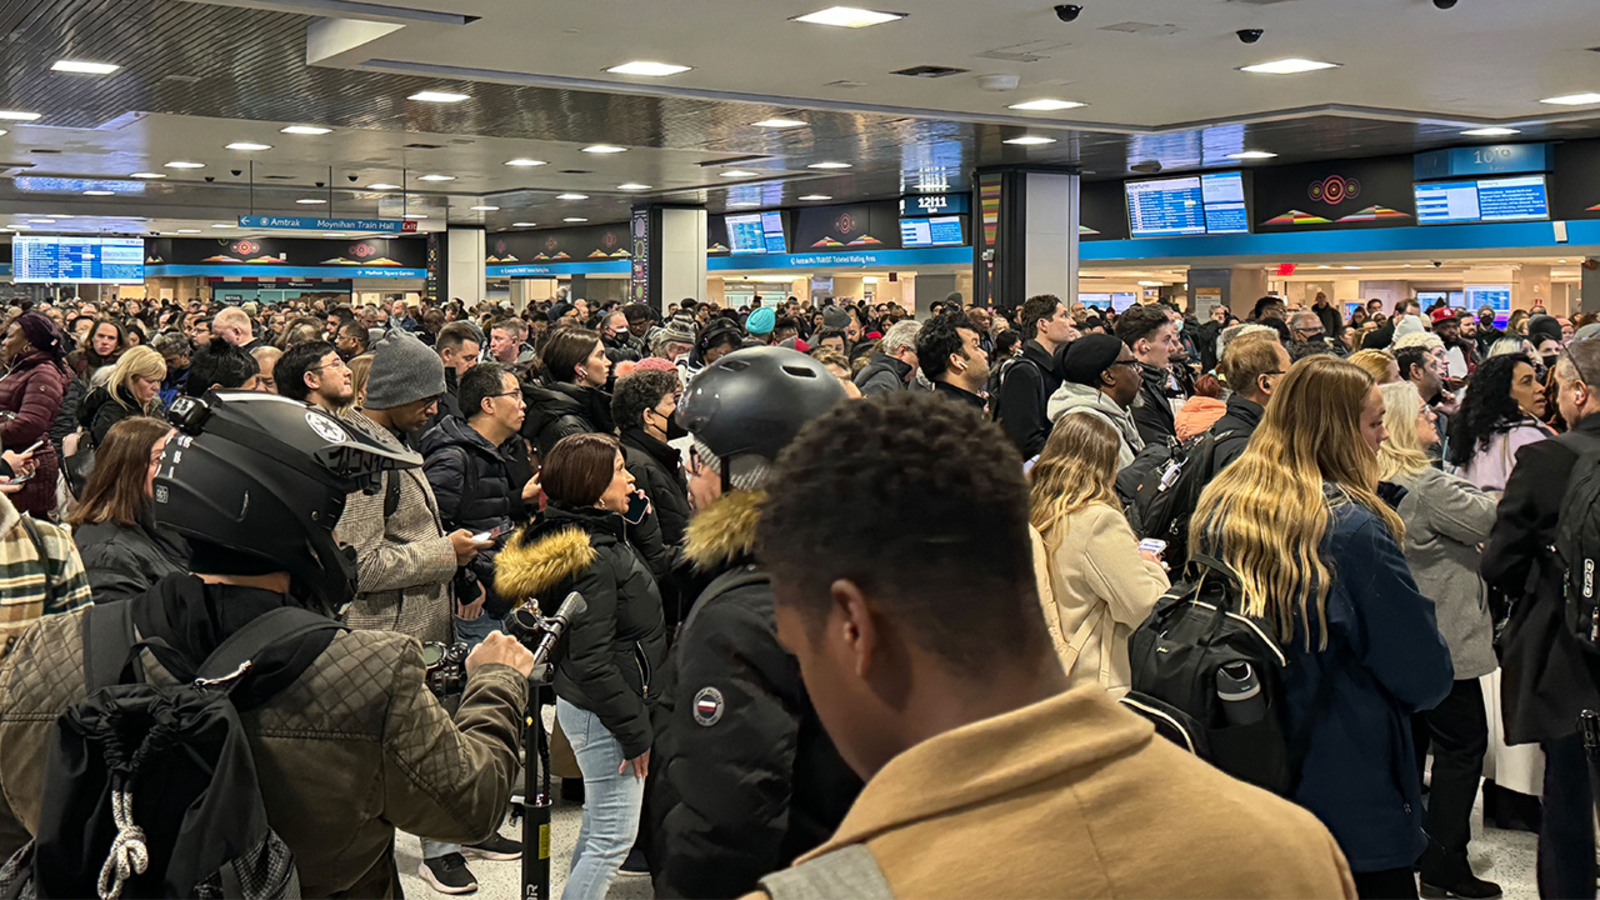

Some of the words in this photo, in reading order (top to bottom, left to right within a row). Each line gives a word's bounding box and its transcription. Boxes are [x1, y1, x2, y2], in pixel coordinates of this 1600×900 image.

[270, 218, 300, 227] Amtrak
[317, 219, 355, 229] Moynihan
[358, 220, 377, 229] Train
[379, 221, 395, 230] Hall
[402, 221, 417, 231] Exit
